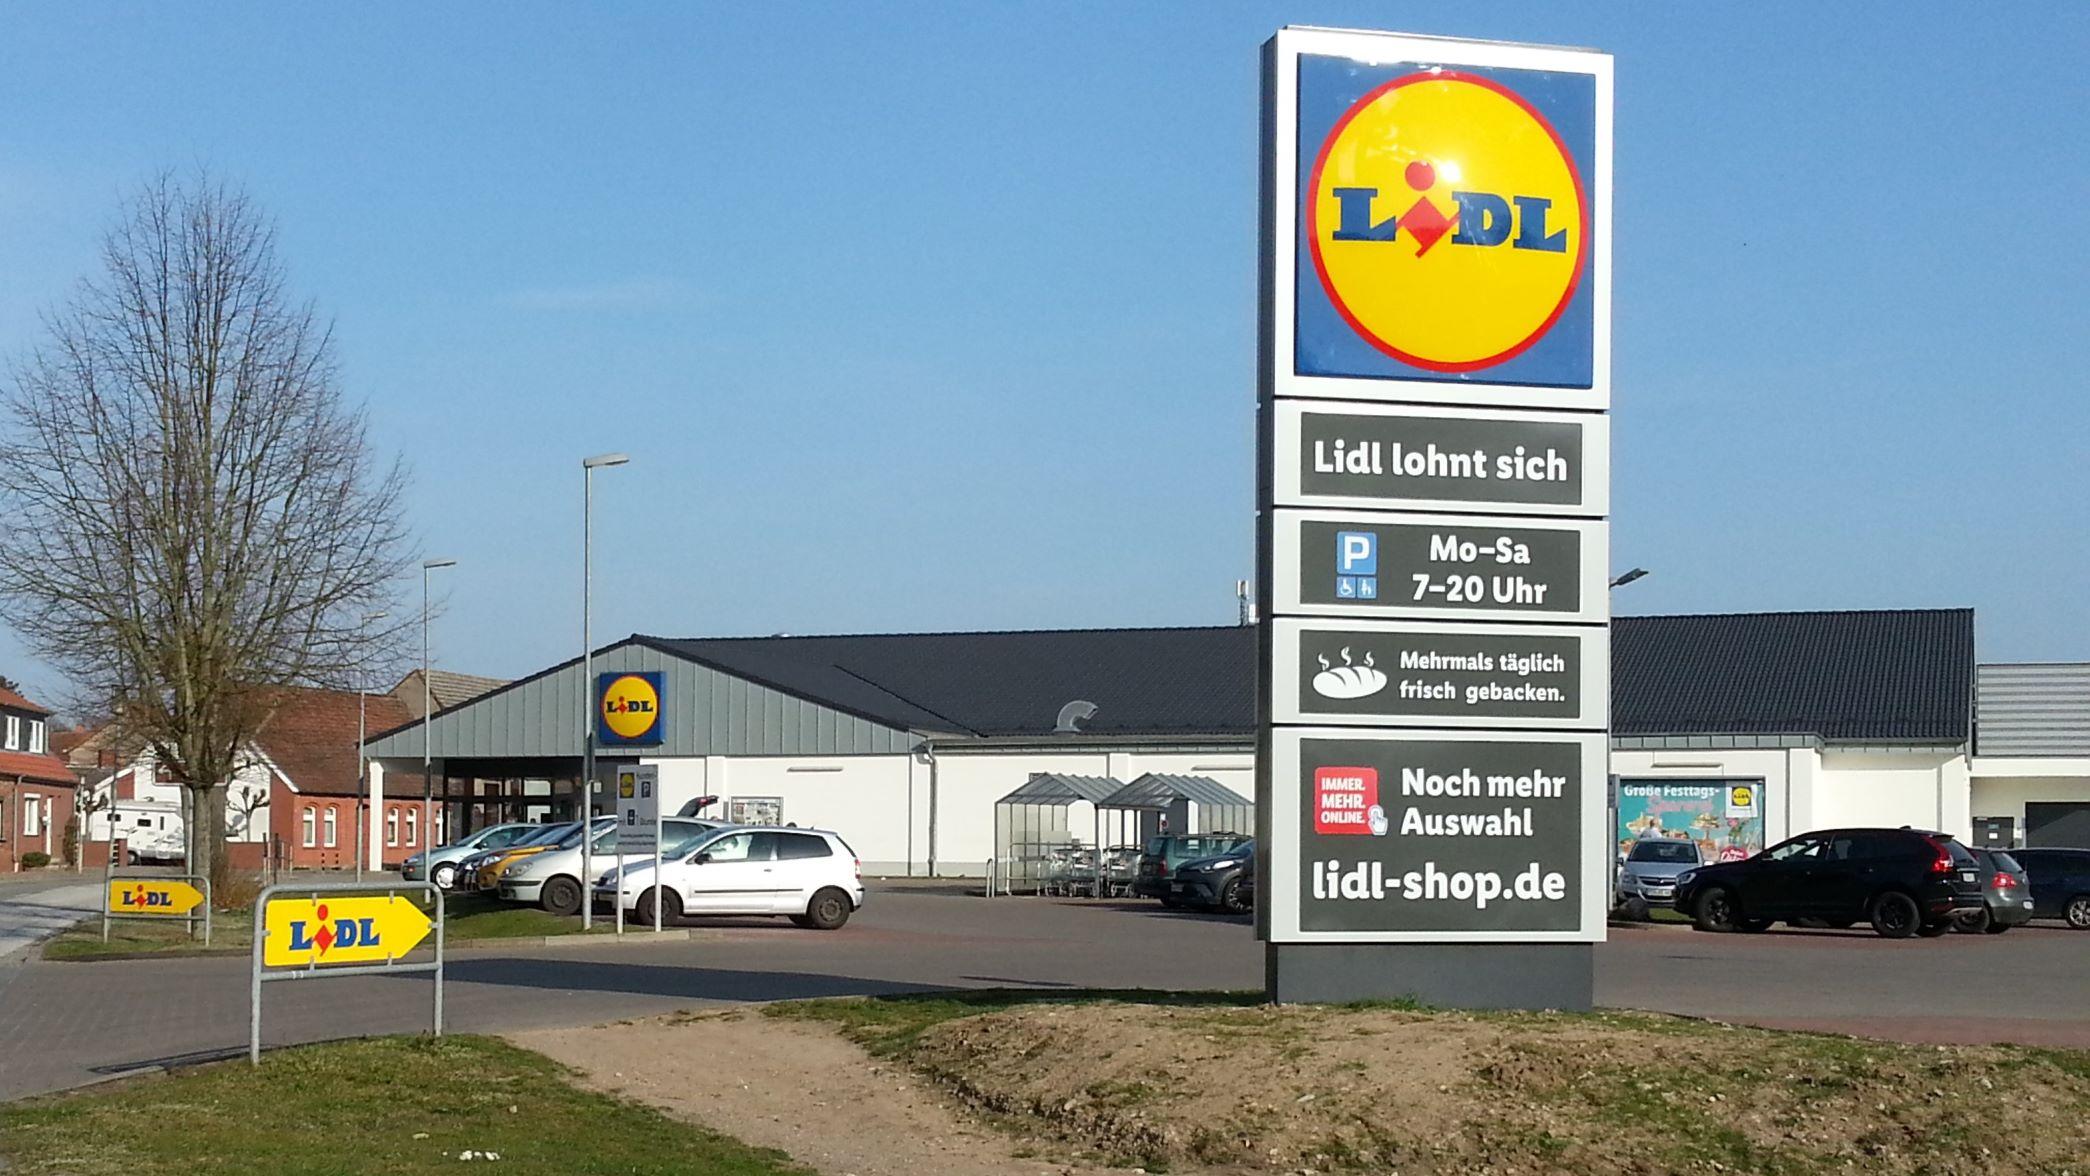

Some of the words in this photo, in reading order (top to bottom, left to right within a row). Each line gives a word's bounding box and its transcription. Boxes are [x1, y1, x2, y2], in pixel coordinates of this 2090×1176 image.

[1314, 439, 1383, 475] Lidl
[1392, 443, 1488, 479] lohnt
[1496, 446, 1568, 481] sich
[1344, 537, 1369, 570] P
[1492, 576, 1548, 604] Uhr
[1400, 651, 1494, 671] Mehrmals
[1499, 652, 1565, 676] täglich
[1400, 680, 1456, 700] frisch
[1465, 682, 1566, 705] gebacken.
[1321, 777, 1366, 791] IMMER.
[1401, 768, 1481, 797] Noch
[1486, 769, 1567, 798] mehr
[1321, 793, 1366, 809] MEHR.
[1321, 811, 1366, 824] ONLINE.
[1400, 808, 1534, 837] Auswahl
[1313, 860, 1566, 909] lidl-shop.de
